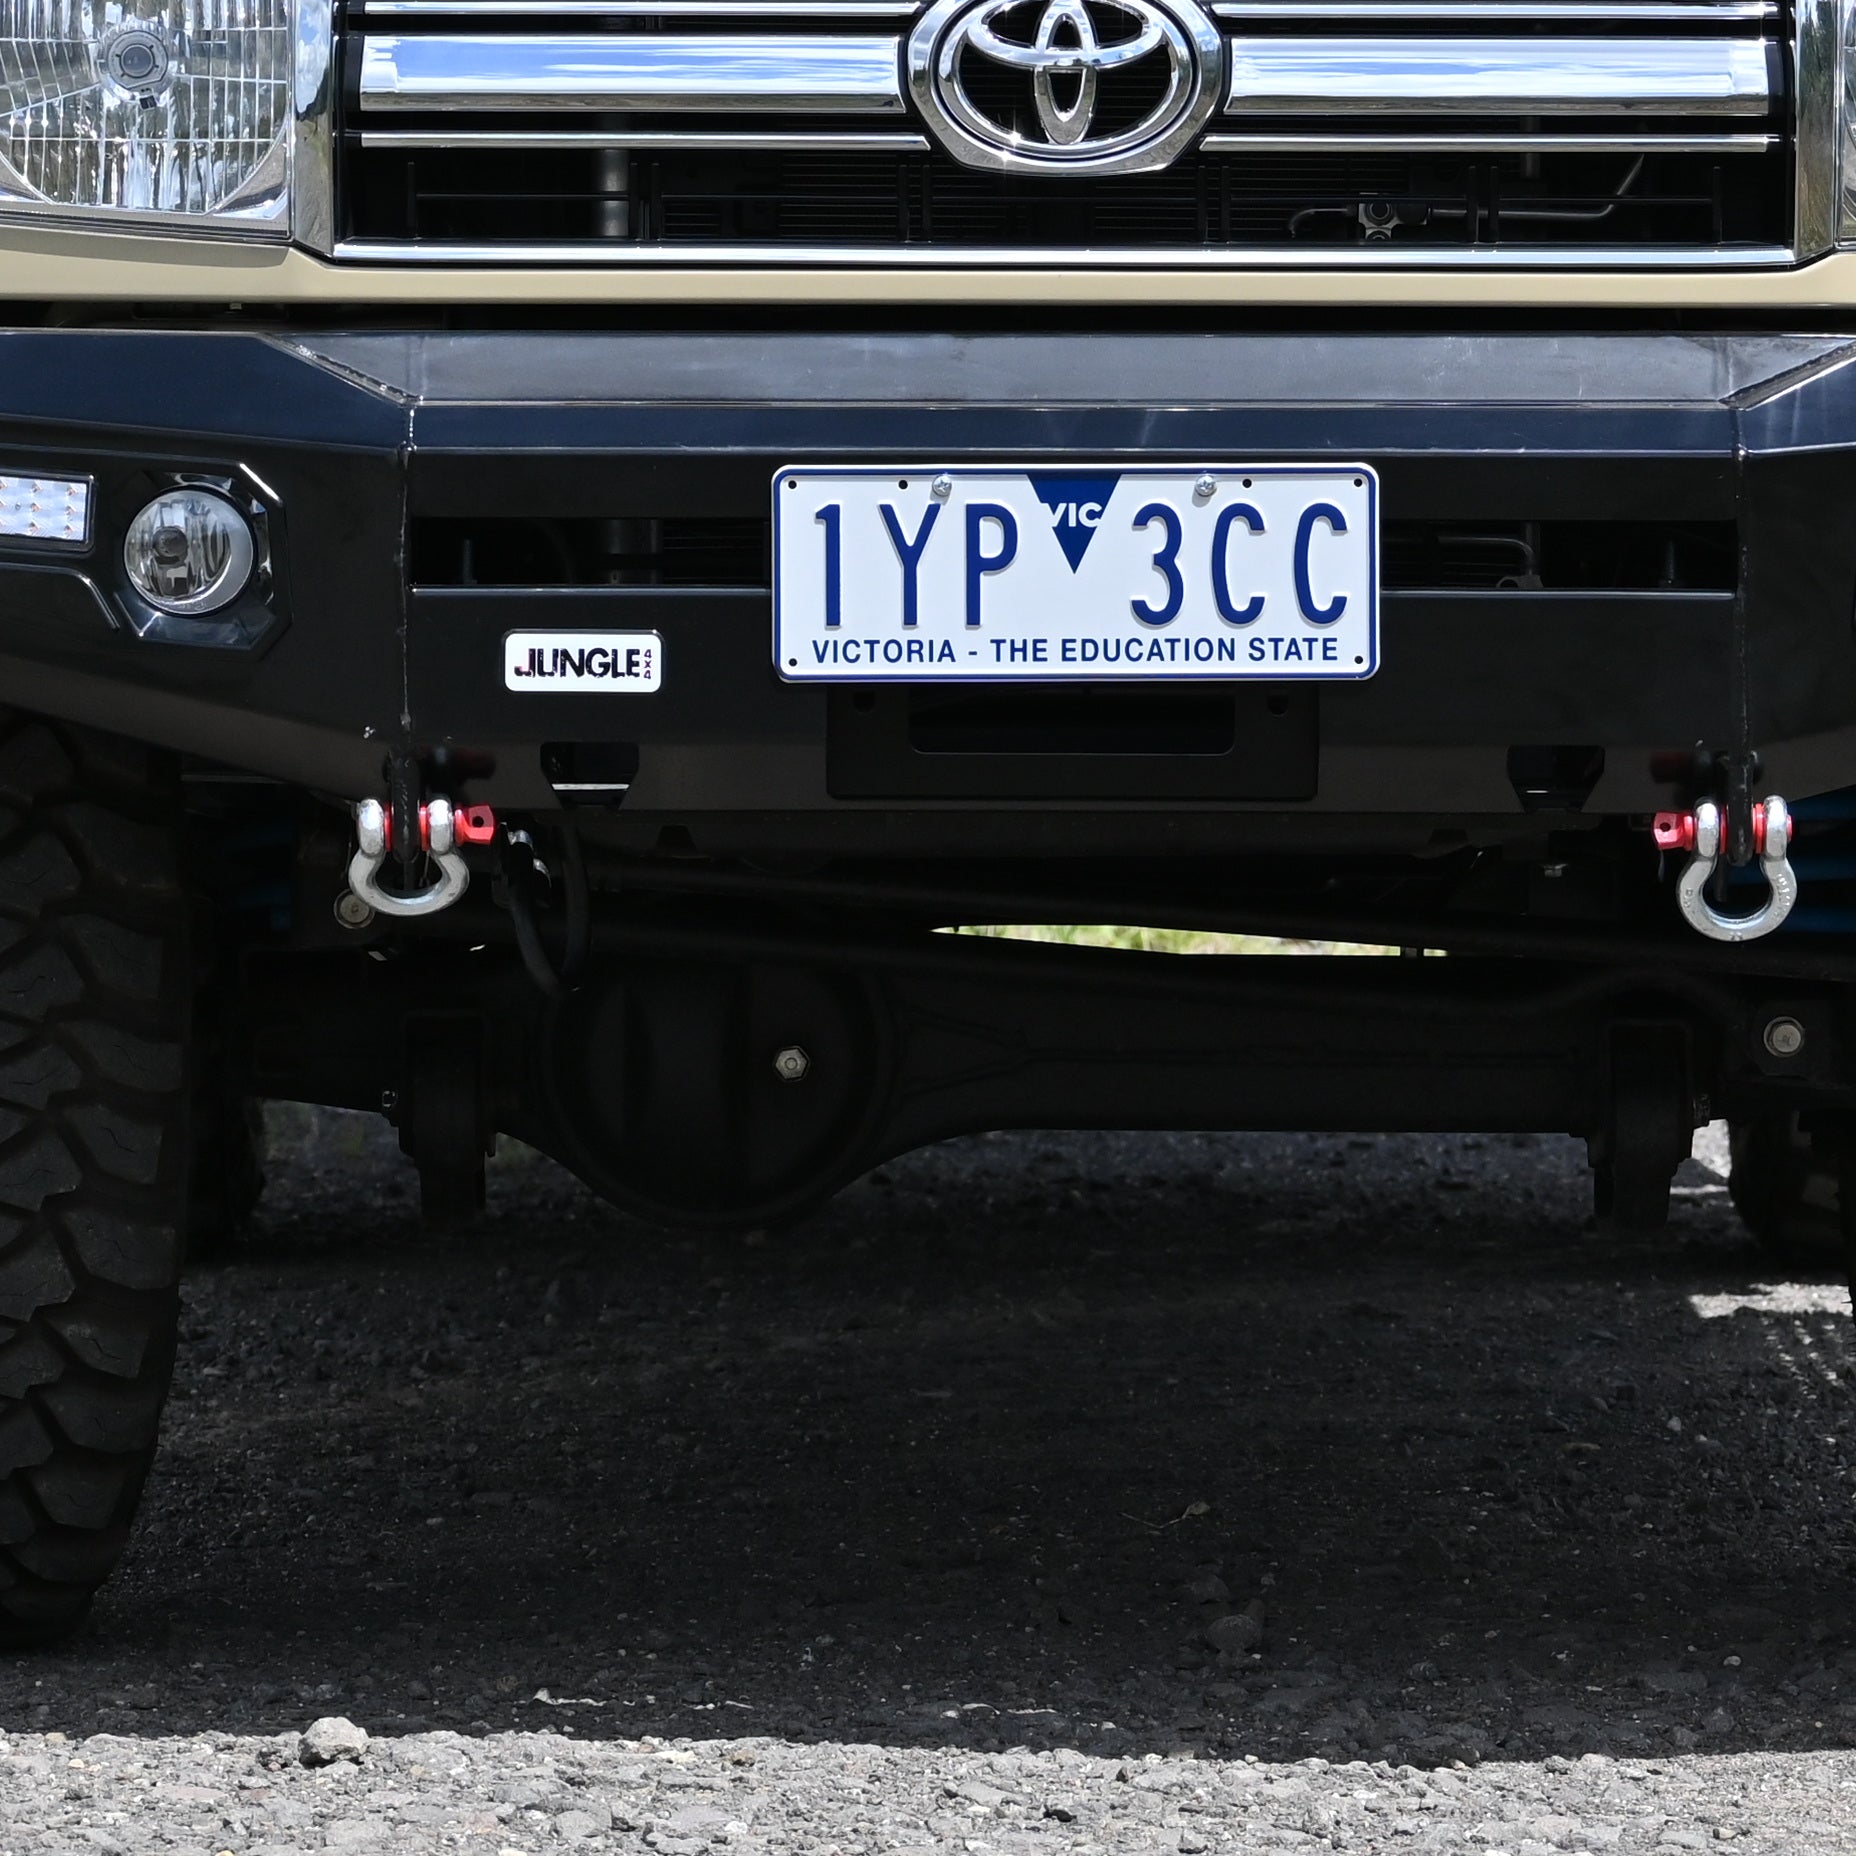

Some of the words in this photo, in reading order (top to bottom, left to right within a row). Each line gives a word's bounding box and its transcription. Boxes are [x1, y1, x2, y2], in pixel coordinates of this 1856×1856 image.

[1041, 502, 1104, 528] VIC
[814, 502, 1019, 627] 1YP
[1131, 501, 1349, 626] 3CC
[514, 647, 640, 678] JUNGLE
[811, 639, 957, 664] VICTORIA
[989, 638, 1055, 663] THE
[1061, 638, 1236, 663] EDUCATION
[1248, 637, 1339, 662] STATE
